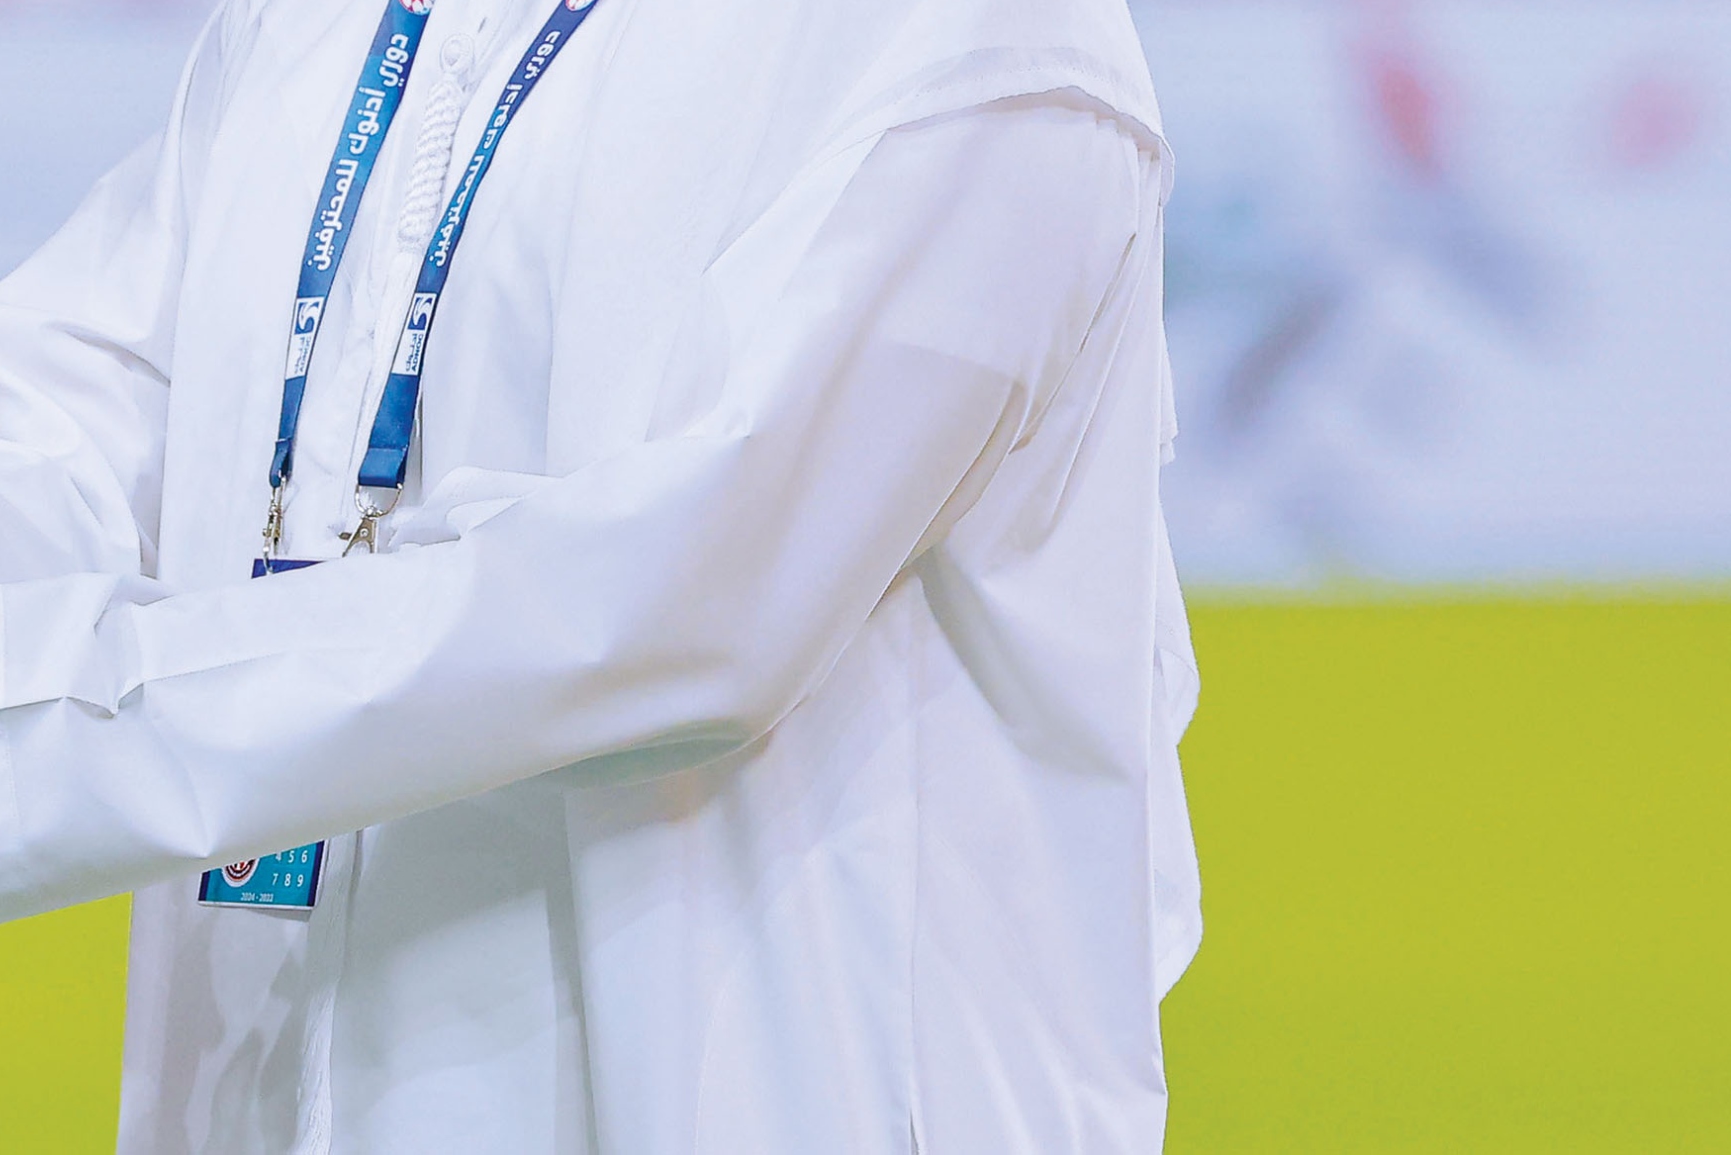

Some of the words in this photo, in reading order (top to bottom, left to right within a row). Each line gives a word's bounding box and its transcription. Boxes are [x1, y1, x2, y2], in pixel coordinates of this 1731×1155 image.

[379, 33, 409, 88] دوري
[288, 850, 295, 863] 5
[301, 850, 308, 863] 6
[272, 873, 279, 886] 7
[284, 873, 291, 887] 8
[296, 874, 304, 887] 9
